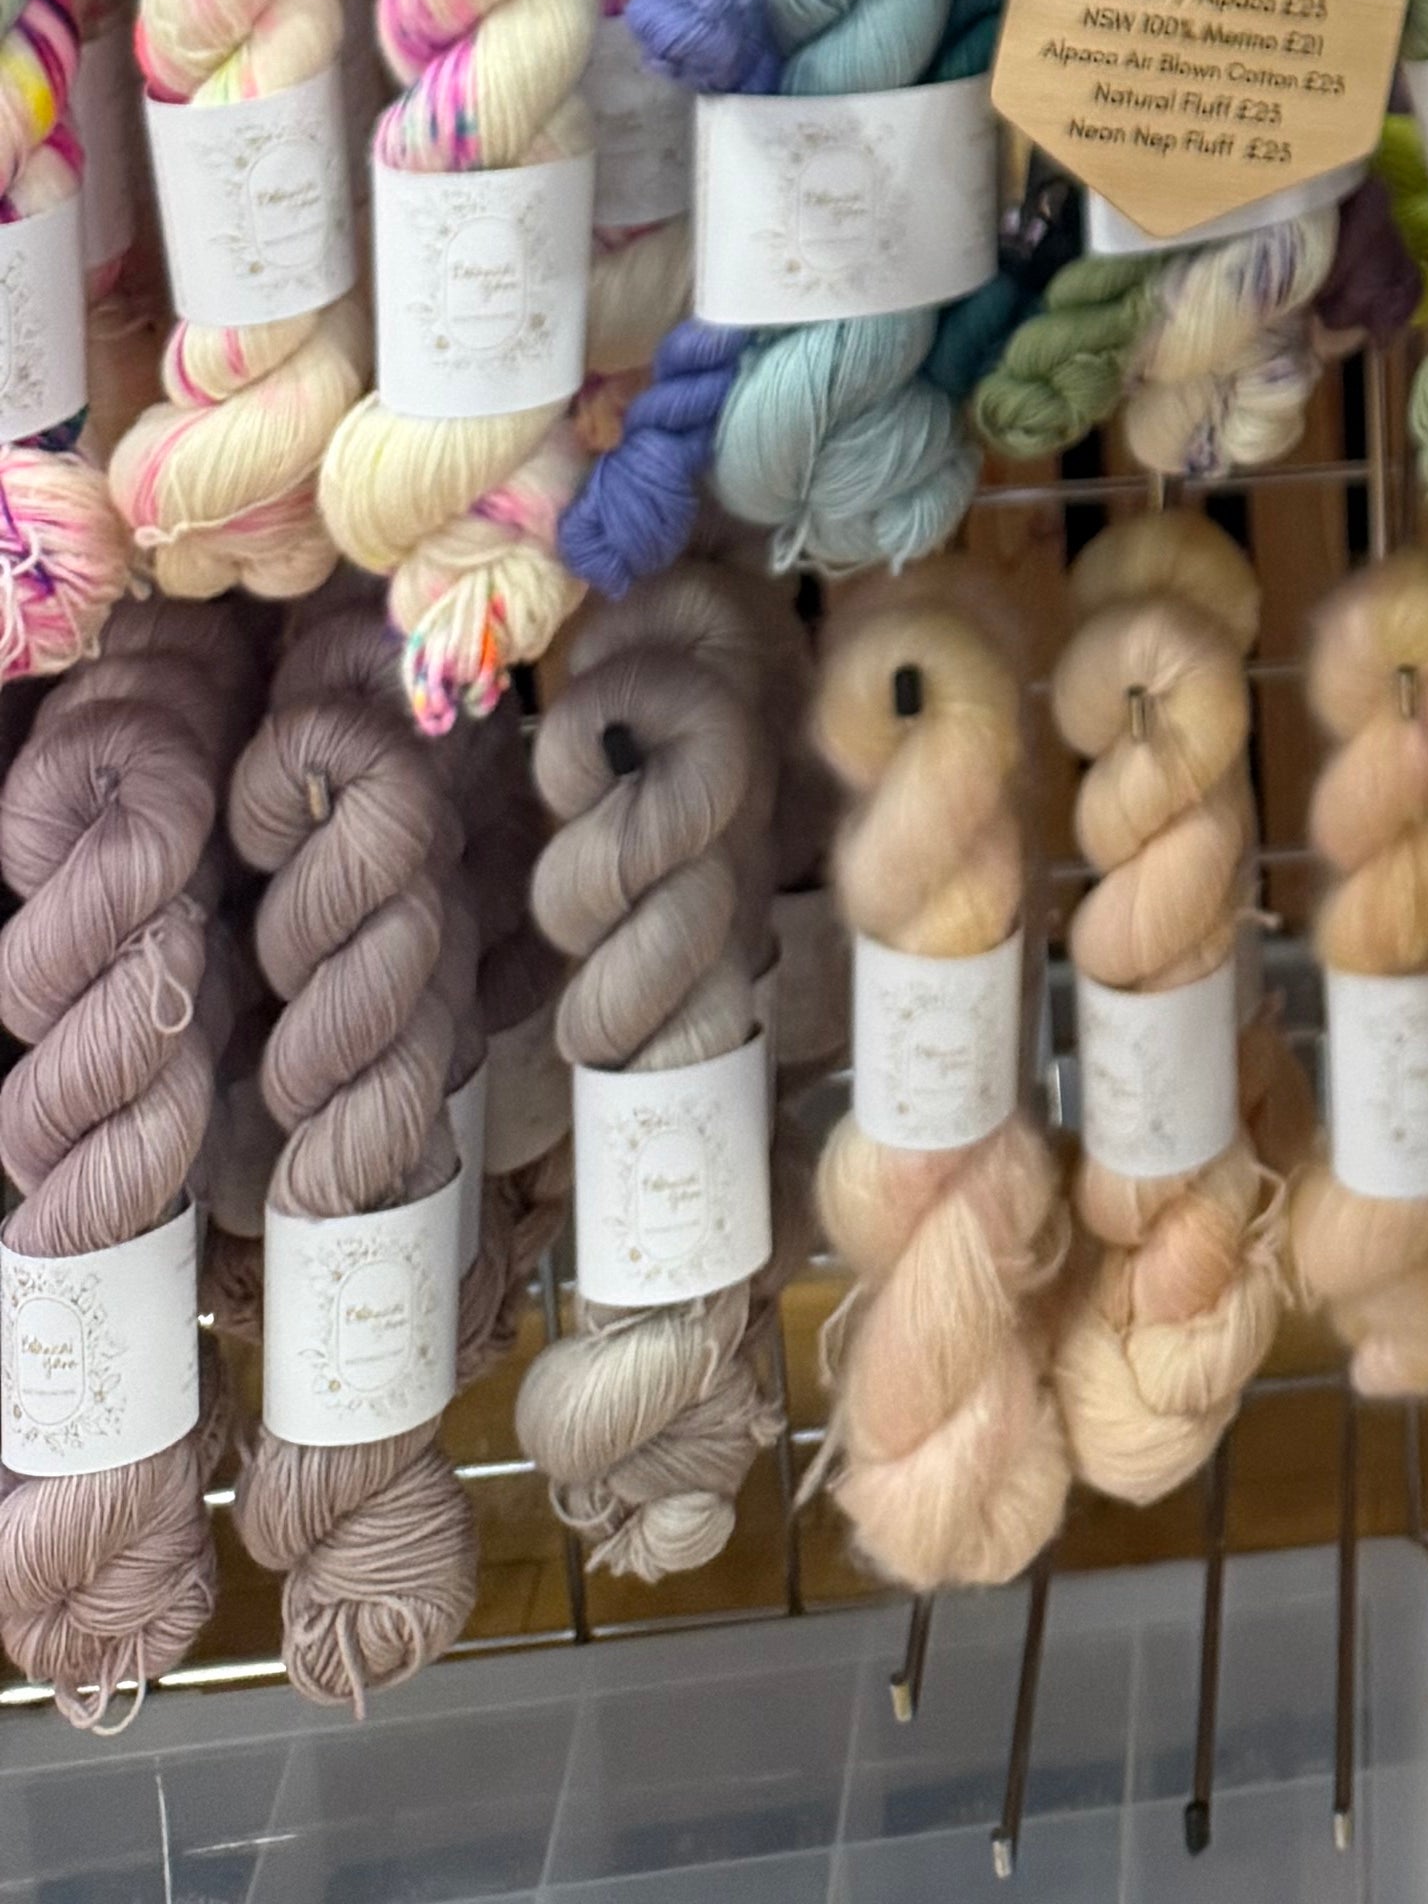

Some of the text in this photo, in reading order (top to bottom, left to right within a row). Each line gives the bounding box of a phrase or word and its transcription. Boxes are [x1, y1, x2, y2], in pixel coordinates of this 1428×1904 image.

[1082, 6, 1136, 34] NSW
[1141, 13, 1195, 41] 100%
[1202, 21, 1279, 50] Merino
[1041, 37, 1119, 68] Alpaca
[1123, 50, 1153, 71] Air
[1159, 52, 1221, 80] Blown
[1226, 60, 1299, 89] Cotton
[1094, 81, 1176, 112] Natural
[1182, 90, 1232, 119] Fluff
[1068, 117, 1126, 143] Neon
[1133, 125, 1178, 157] Nep
[1185, 130, 1234, 157] Fluff
